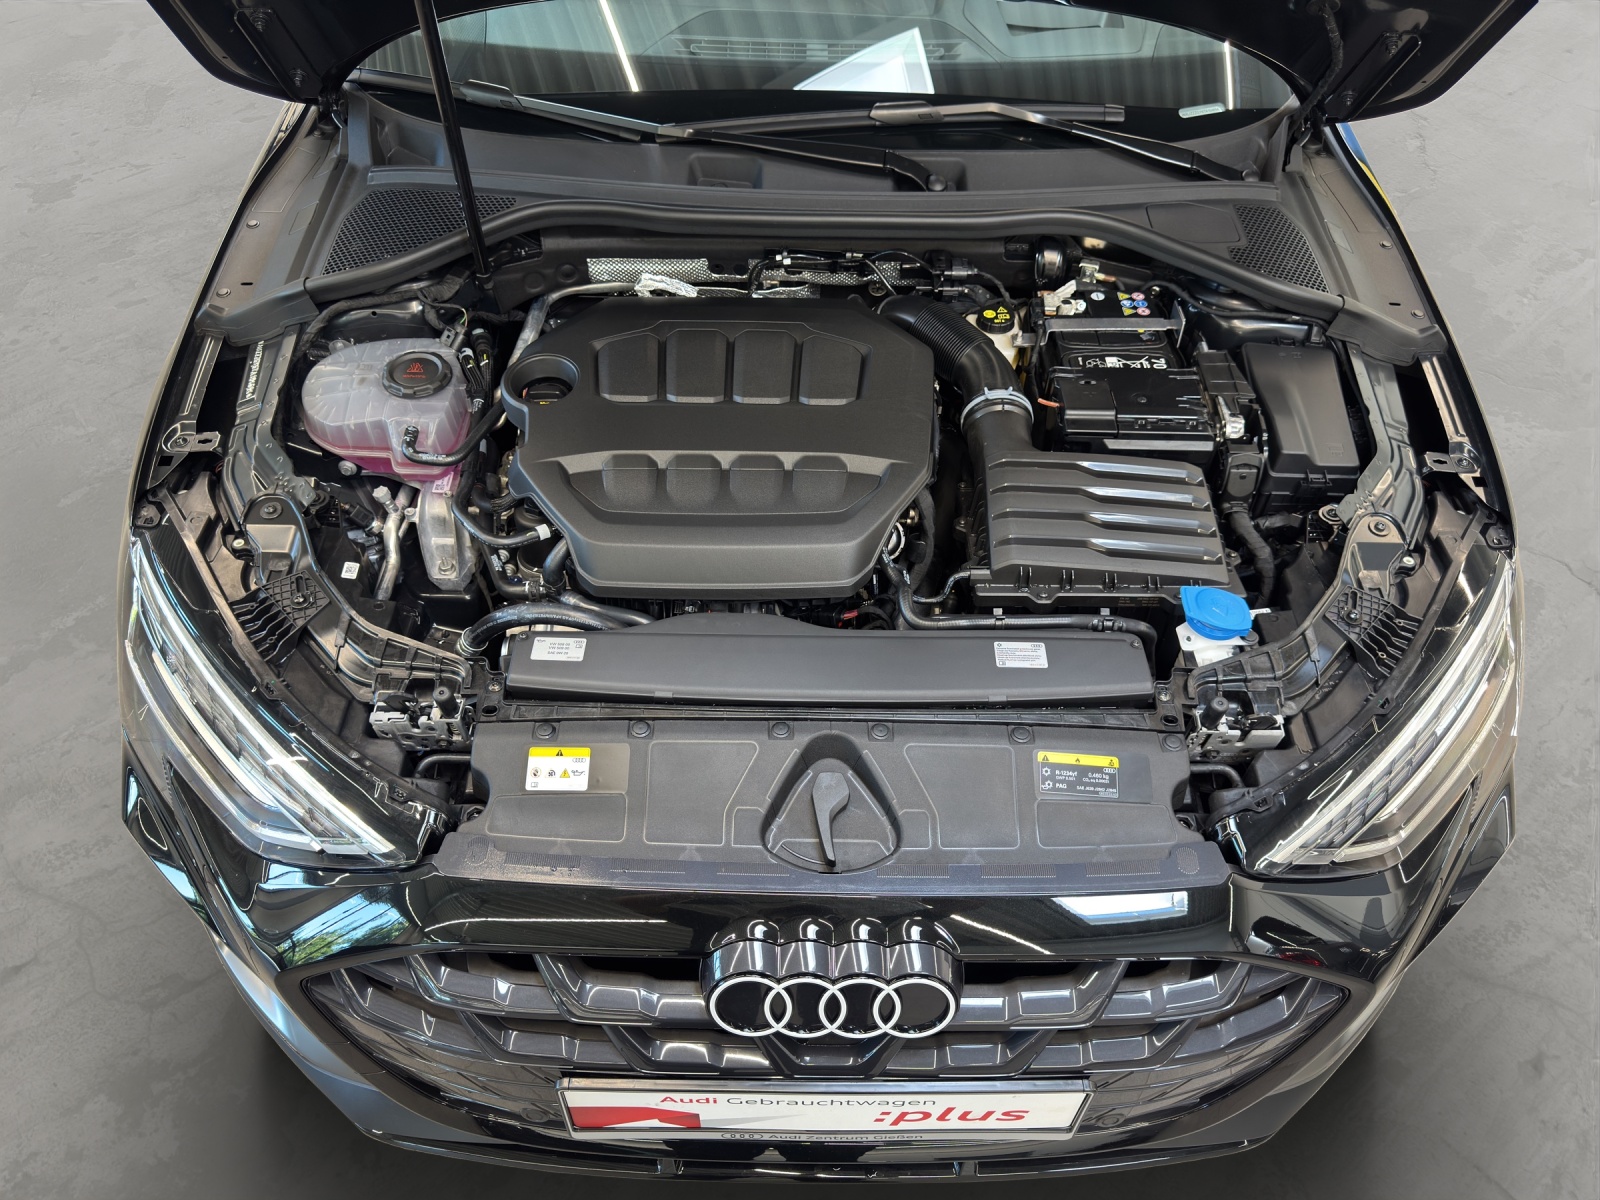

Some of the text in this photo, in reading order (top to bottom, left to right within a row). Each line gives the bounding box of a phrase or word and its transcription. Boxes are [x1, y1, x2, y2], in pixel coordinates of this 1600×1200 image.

[660, 1096, 936, 1107] Audi Gebrauchtwagen
[873, 1106, 1030, 1126] :plus
